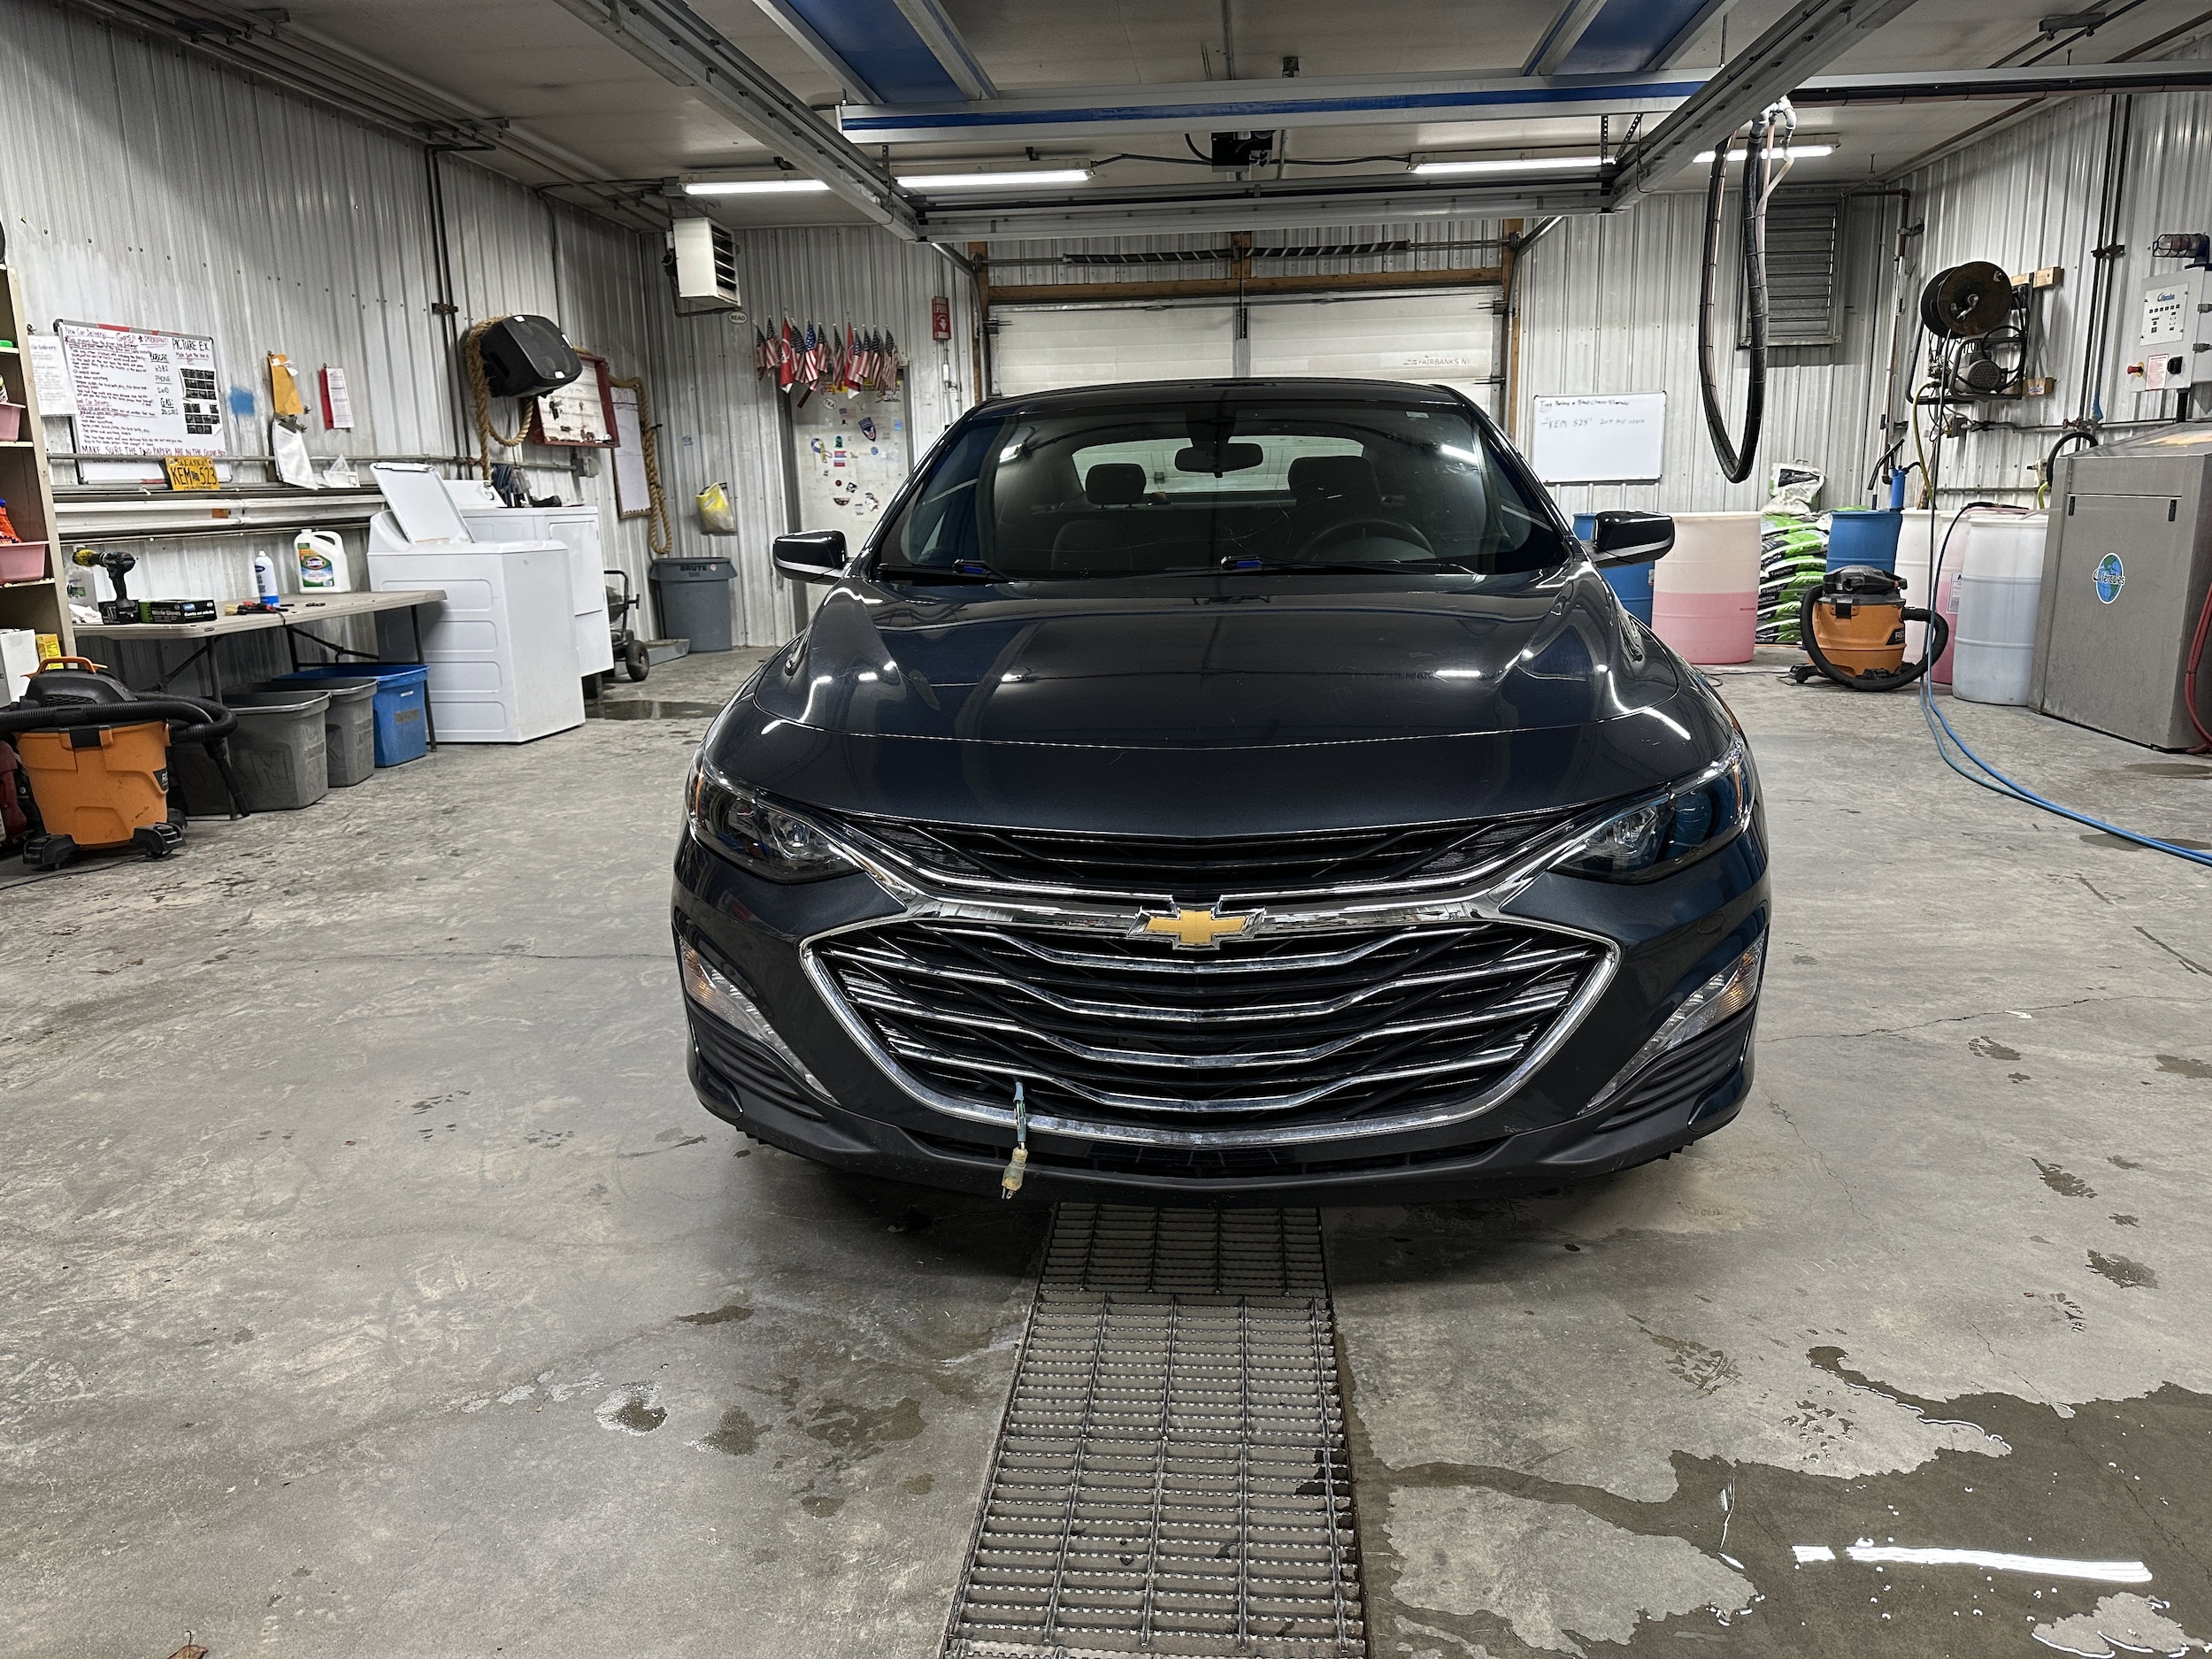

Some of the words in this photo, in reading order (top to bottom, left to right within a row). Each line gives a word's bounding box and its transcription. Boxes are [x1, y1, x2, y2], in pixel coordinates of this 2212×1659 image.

[172, 337, 197, 350] PICTURE
[81, 445, 100, 454] MAKE
[105, 445, 122, 455] SURE
[124, 446, 137, 455] THE
[139, 447, 151, 456] TWO
[152, 446, 173, 456] PAPERS
[170, 466, 193, 485] KEM
[199, 466, 218, 485] 523
